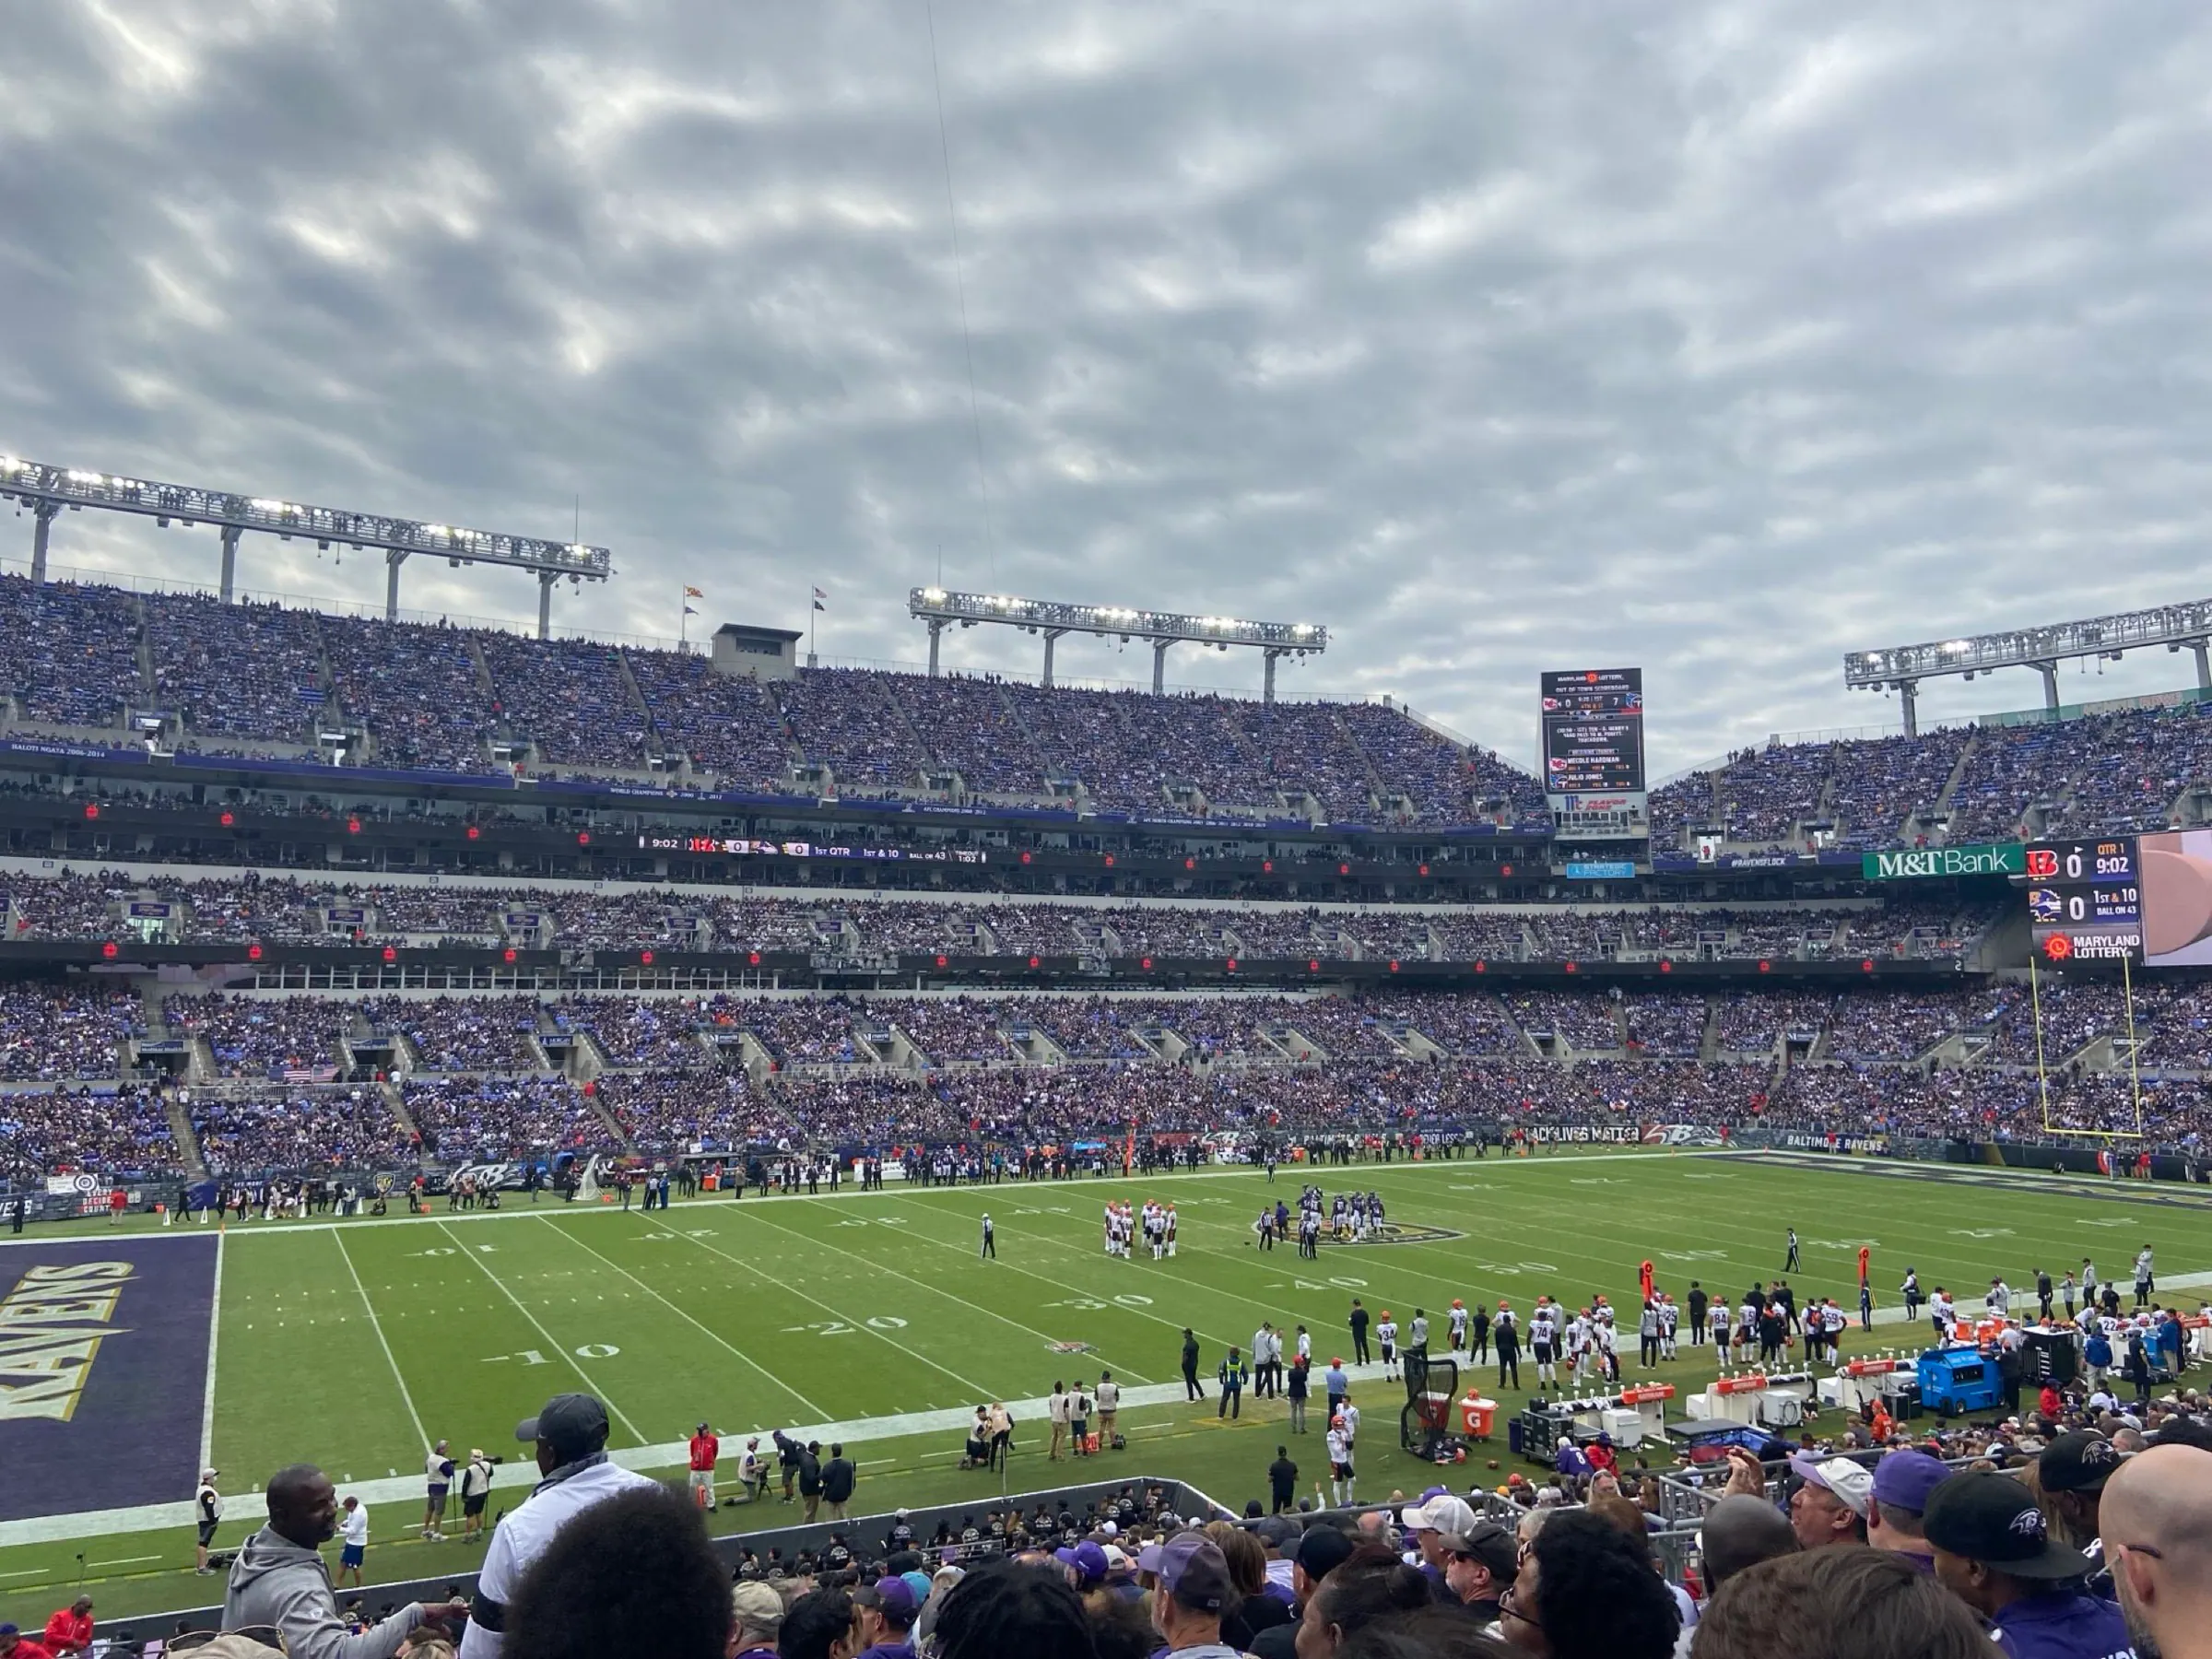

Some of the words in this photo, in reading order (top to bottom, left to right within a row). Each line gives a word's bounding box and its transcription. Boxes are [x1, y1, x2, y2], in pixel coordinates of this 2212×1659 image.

[1565, 699, 1571, 708] 0
[1613, 698, 1618, 706] 7
[11, 743, 39, 752] HALOTI
[41, 747, 65, 755] NGATA
[66, 748, 105, 758] 2006-2014
[653, 839, 678, 848] 9:02
[733, 842, 742, 852] 0
[795, 844, 804, 854] 0
[815, 846, 828, 855] 1ST
[830, 847, 851, 856] QTR
[864, 849, 876, 857] 1ST
[878, 849, 886, 858] &
[888, 849, 899, 858] 10
[934, 852, 946, 860] 43
[2097, 843, 2116, 855] QTR
[2120, 843, 2124, 853] 1
[1731, 857, 1786, 868] #RAVENSFLOCK
[1877, 851, 1942, 877] M&T
[1945, 847, 2009, 874] Bank
[2066, 853, 2082, 878] 0
[2096, 856, 2129, 875] 9:02
[2093, 890, 2110, 903] 1ST
[2112, 892, 2119, 902] &
[2122, 888, 2136, 902] 10
[2069, 896, 2085, 920] 0
[2097, 907, 2114, 916] BALL
[2115, 906, 2126, 915] ON
[2127, 905, 2136, 914] 43
[2073, 935, 2140, 947] MARYLAND
[2074, 947, 2128, 959] LOTTERY
[1964, 1036, 1992, 1044] GEICO
[1787, 1135, 1841, 1148] BALTIMOE
[1844, 1138, 1882, 1151] RAVENS
[1063, 1294, 1154, 1310] 30
[1714, 1313, 1726, 1324] 84
[1825, 1312, 1838, 1324] 59
[807, 1316, 909, 1335] 20
[2104, 1320, 2117, 1332] 22
[1382, 1331, 1394, 1340] 34
[1536, 1326, 1547, 1338] 74
[514, 1344, 620, 1366] 10
[2067, 1395, 2074, 1406] 9
[1467, 1412, 1481, 1428] G
[1575, 1452, 1586, 1465] 8
[2082, 1537, 2102, 1559] 8
